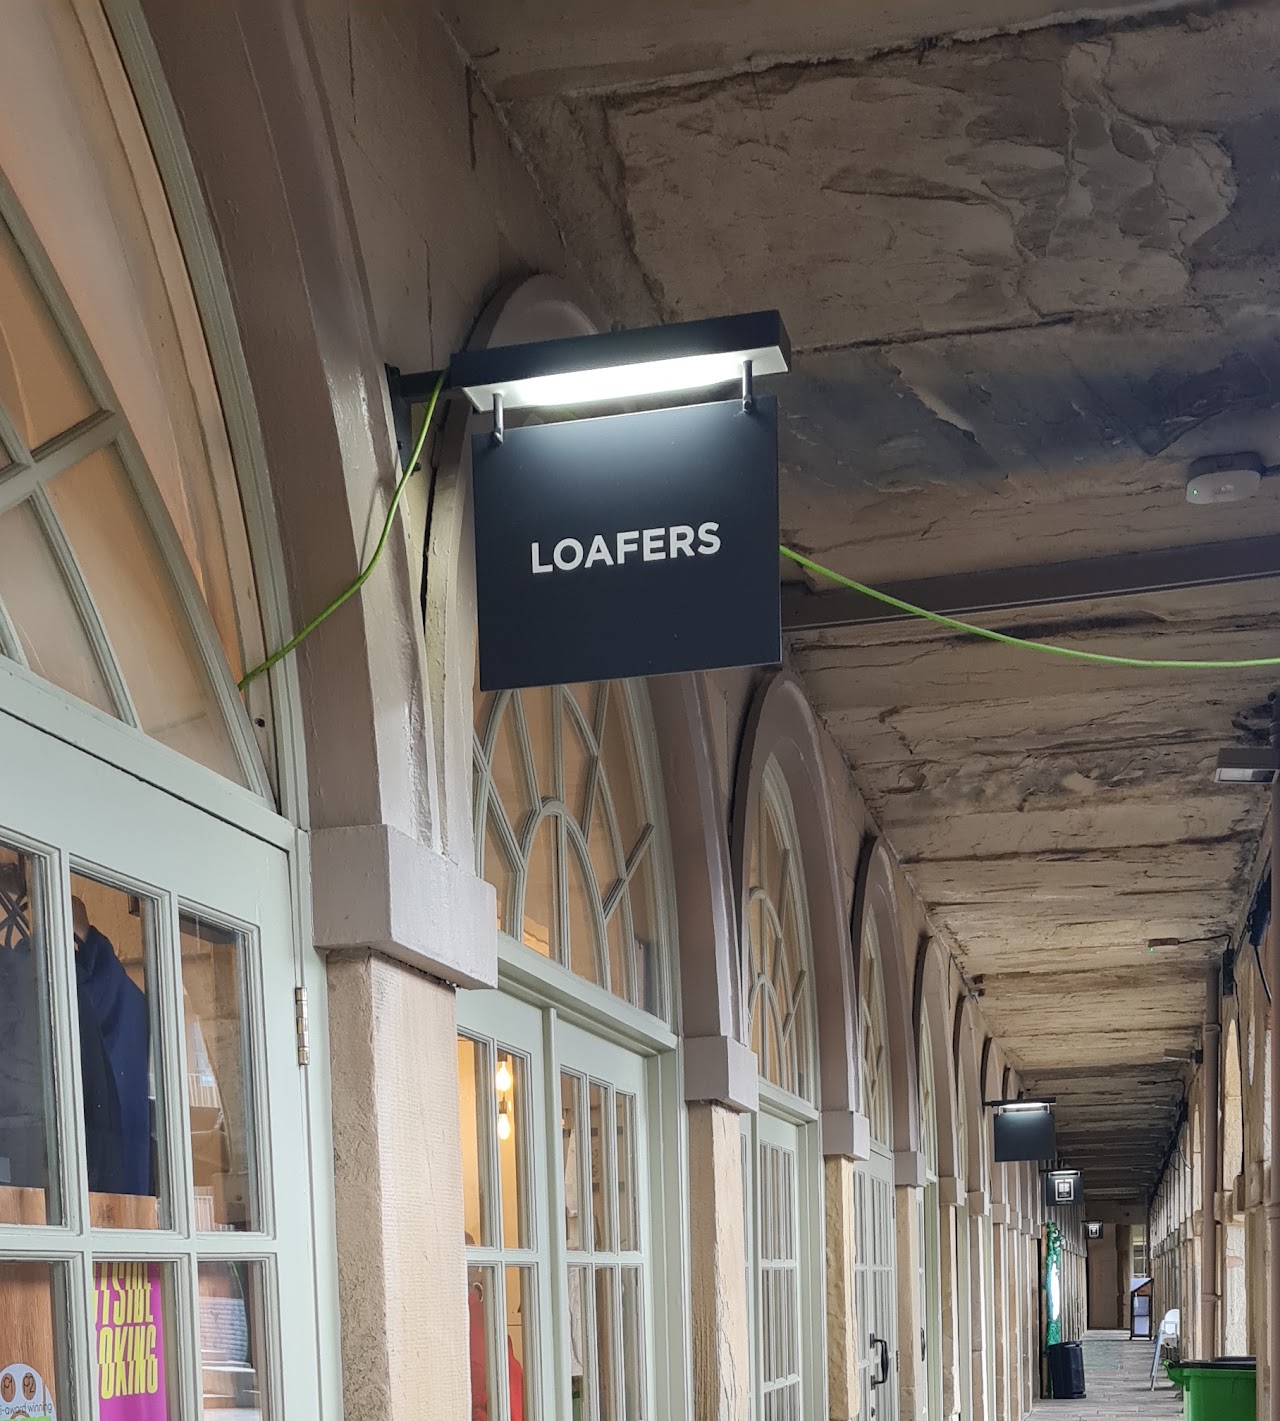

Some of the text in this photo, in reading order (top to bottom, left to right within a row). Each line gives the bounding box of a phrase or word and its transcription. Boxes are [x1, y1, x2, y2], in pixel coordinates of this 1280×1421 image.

[530, 521, 722, 574] LOAFERS
[98, 1324, 158, 1400] OKING
[28, 1402, 52, 1413] winning
